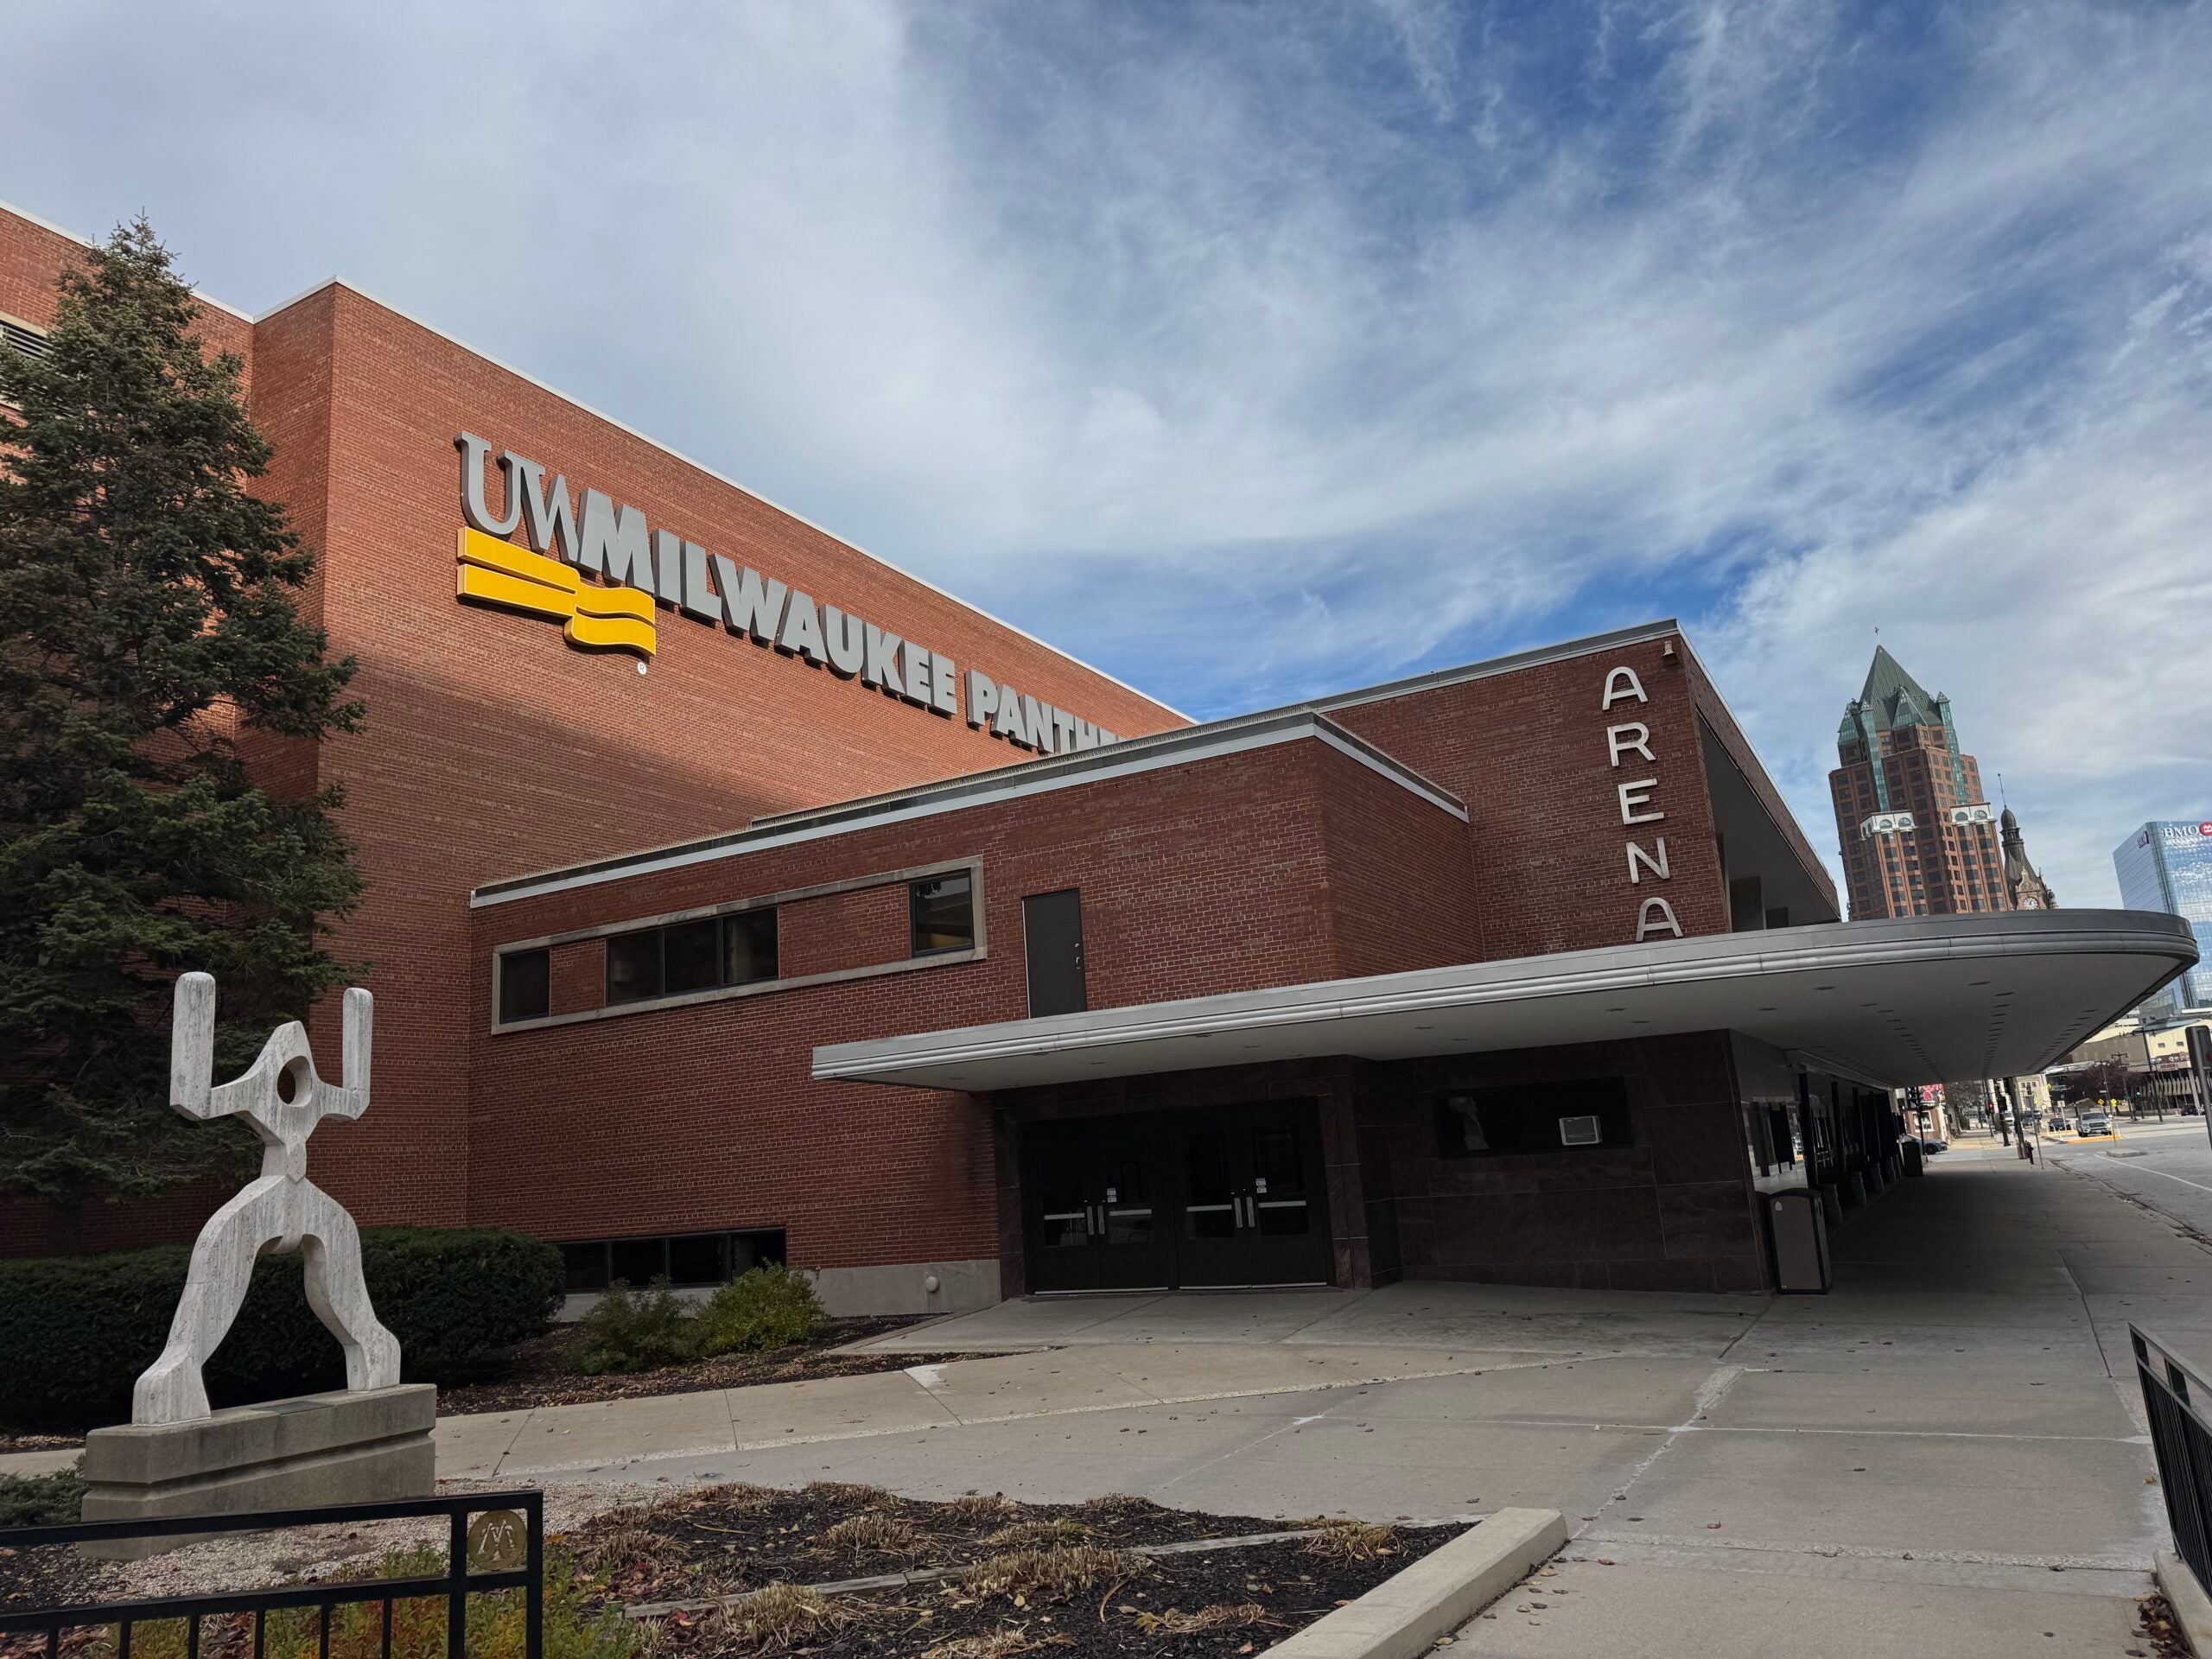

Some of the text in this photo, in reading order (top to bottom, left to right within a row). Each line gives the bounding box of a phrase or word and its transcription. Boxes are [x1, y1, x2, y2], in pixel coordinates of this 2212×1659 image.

[965, 670, 1131, 754] PANTH
[1602, 666, 1684, 943] ARENA
[2163, 824, 2199, 838] BMO
